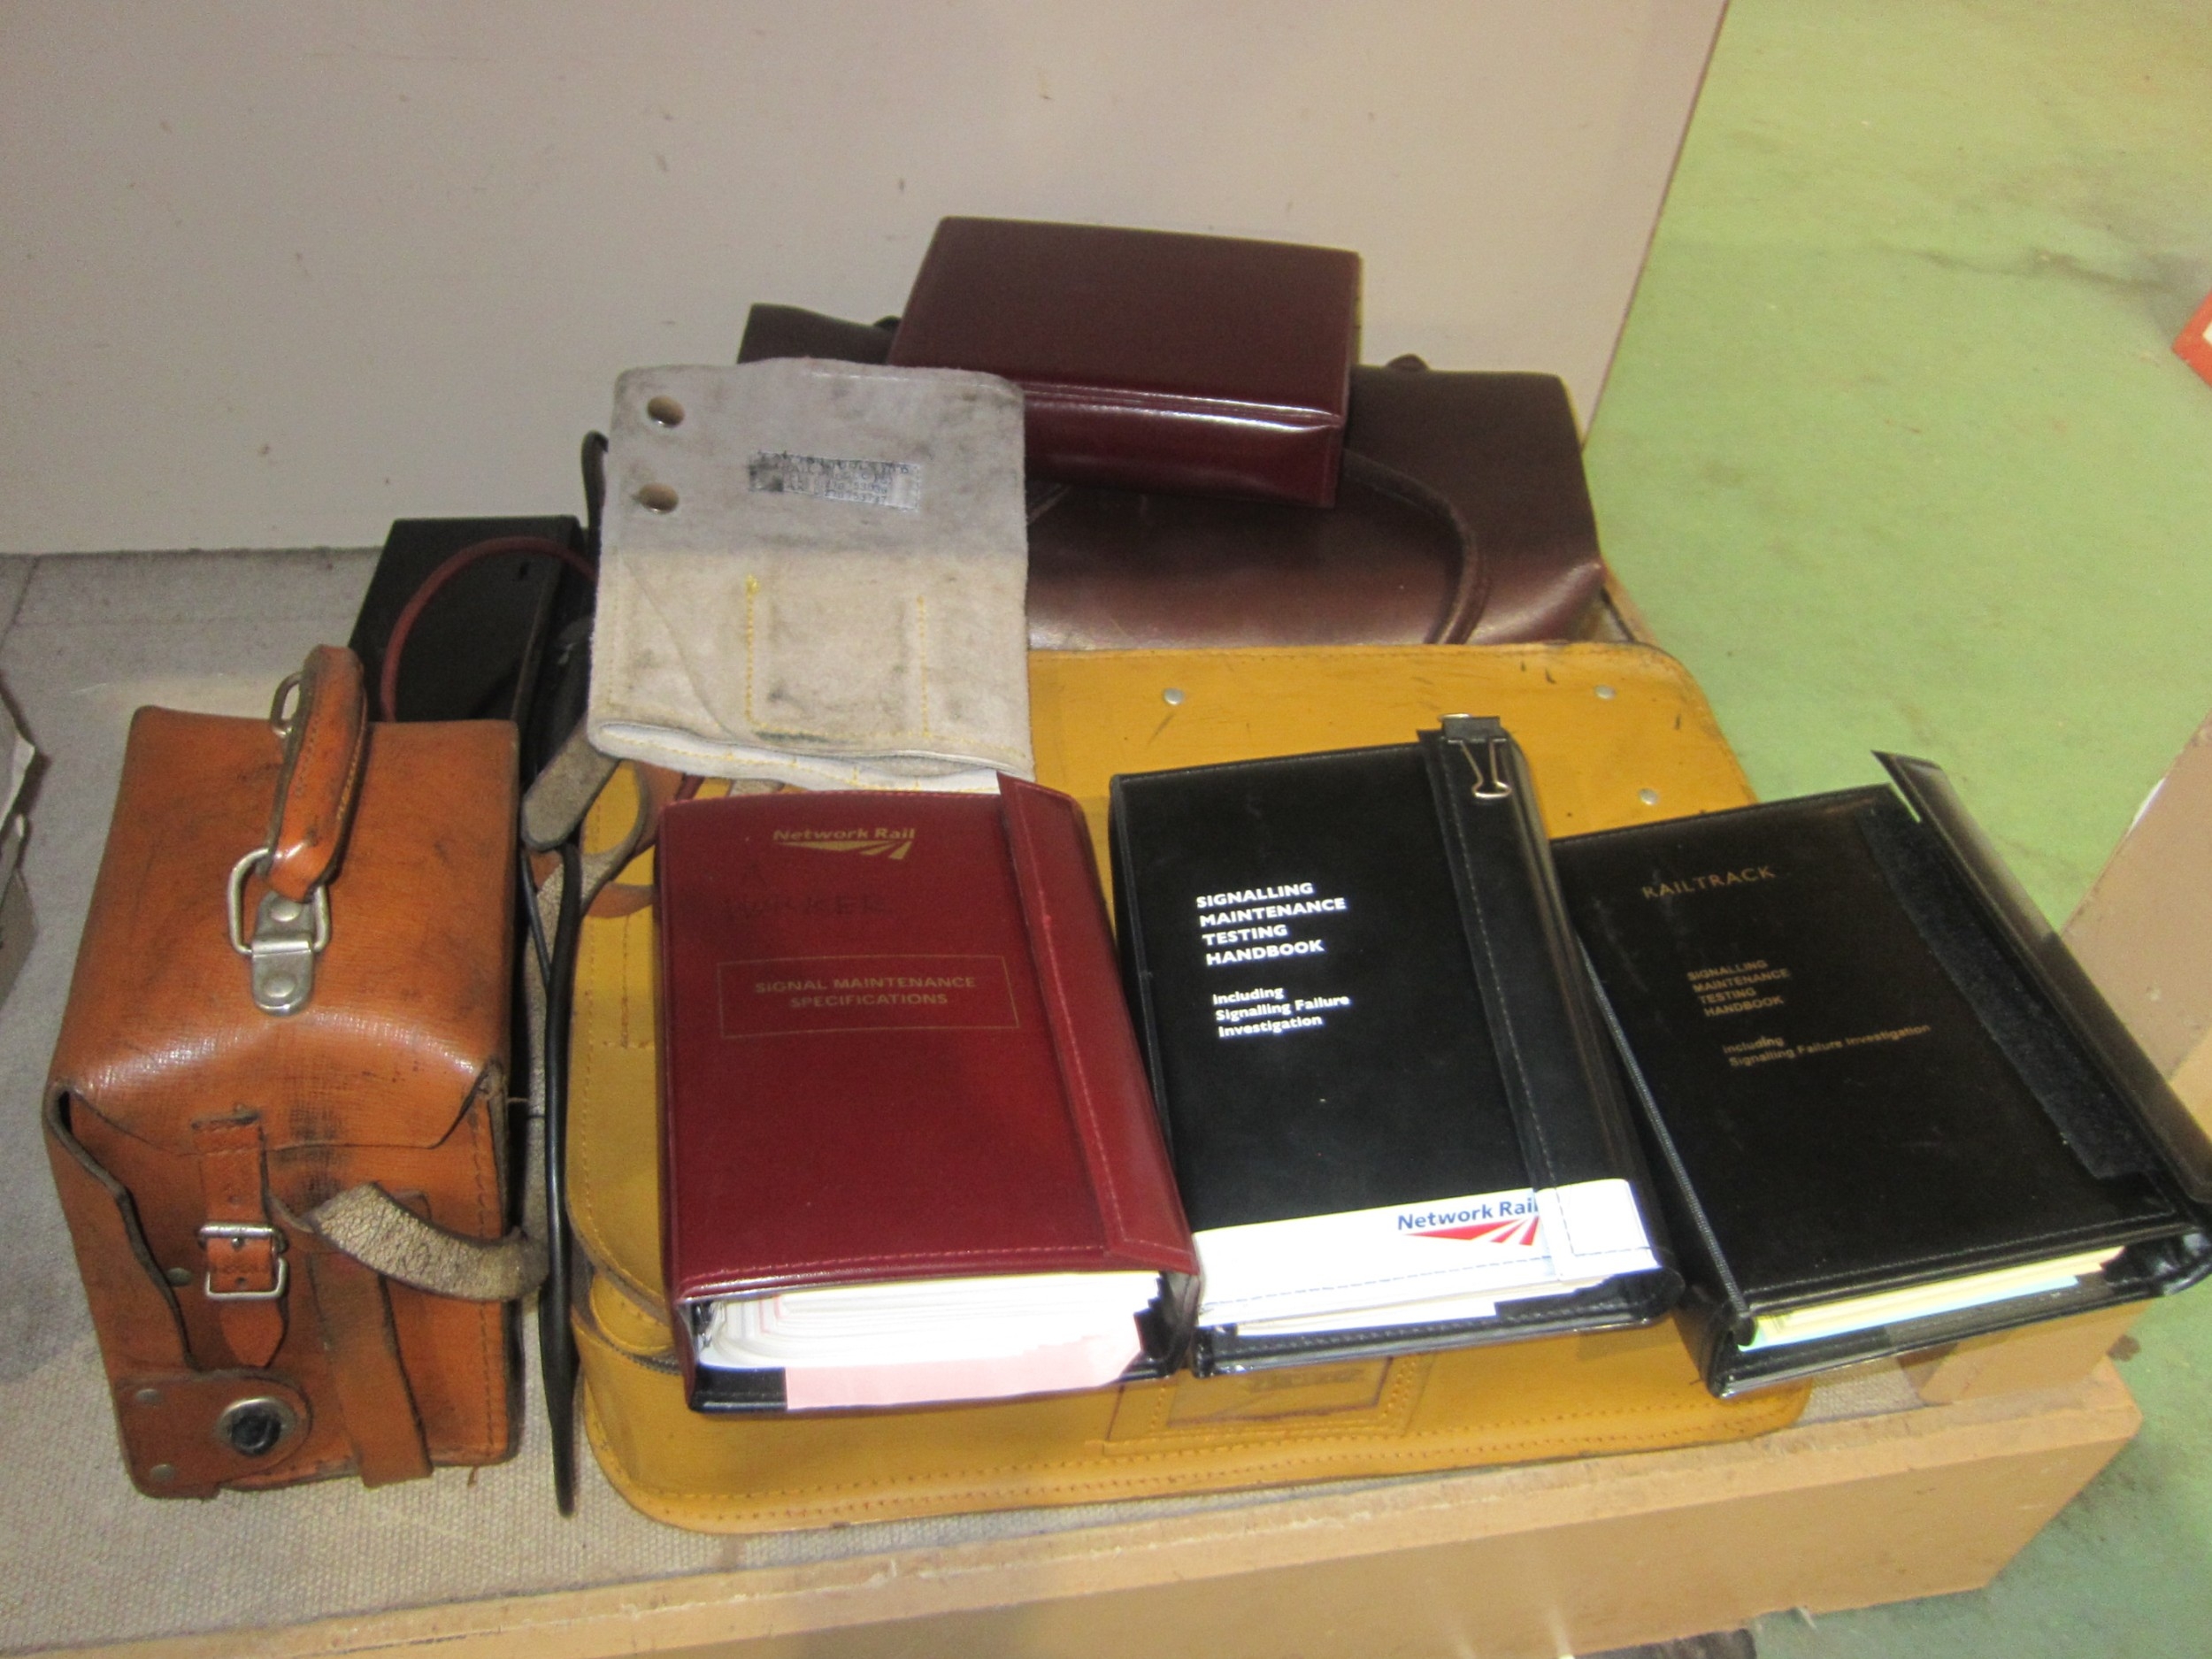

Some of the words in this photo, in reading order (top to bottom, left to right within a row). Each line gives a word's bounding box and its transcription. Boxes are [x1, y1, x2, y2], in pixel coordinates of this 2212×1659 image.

[772, 828, 869, 841] Network
[875, 827, 916, 839] Rail
[1642, 865, 1776, 899] RAILTRACK
[1196, 882, 1315, 909] SIGNALLING
[1199, 897, 1348, 927] MAINTENANCE
[1202, 924, 1288, 946] TESTING
[1205, 939, 1325, 966] HANDBOOK
[1687, 960, 1768, 981] SIGNALLING
[1693, 968, 1790, 992] MAINTENANCE
[755, 980, 827, 993] SIGNAL
[833, 977, 977, 988] MAINTENANCE
[1699, 987, 1756, 1004] TESTING
[790, 993, 949, 1008] SPECIFICATIONS
[1215, 1002, 1292, 1022] Signalling
[1294, 995, 1350, 1011] Failure
[1704, 995, 1785, 1017] HANDBOOK
[1218, 1016, 1323, 1038] Investigation
[1730, 1048, 1795, 1067] Signalling
[1797, 1040, 1843, 1055] Failure
[1845, 1025, 1931, 1046] Investigation
[1398, 1204, 1493, 1230] Network
